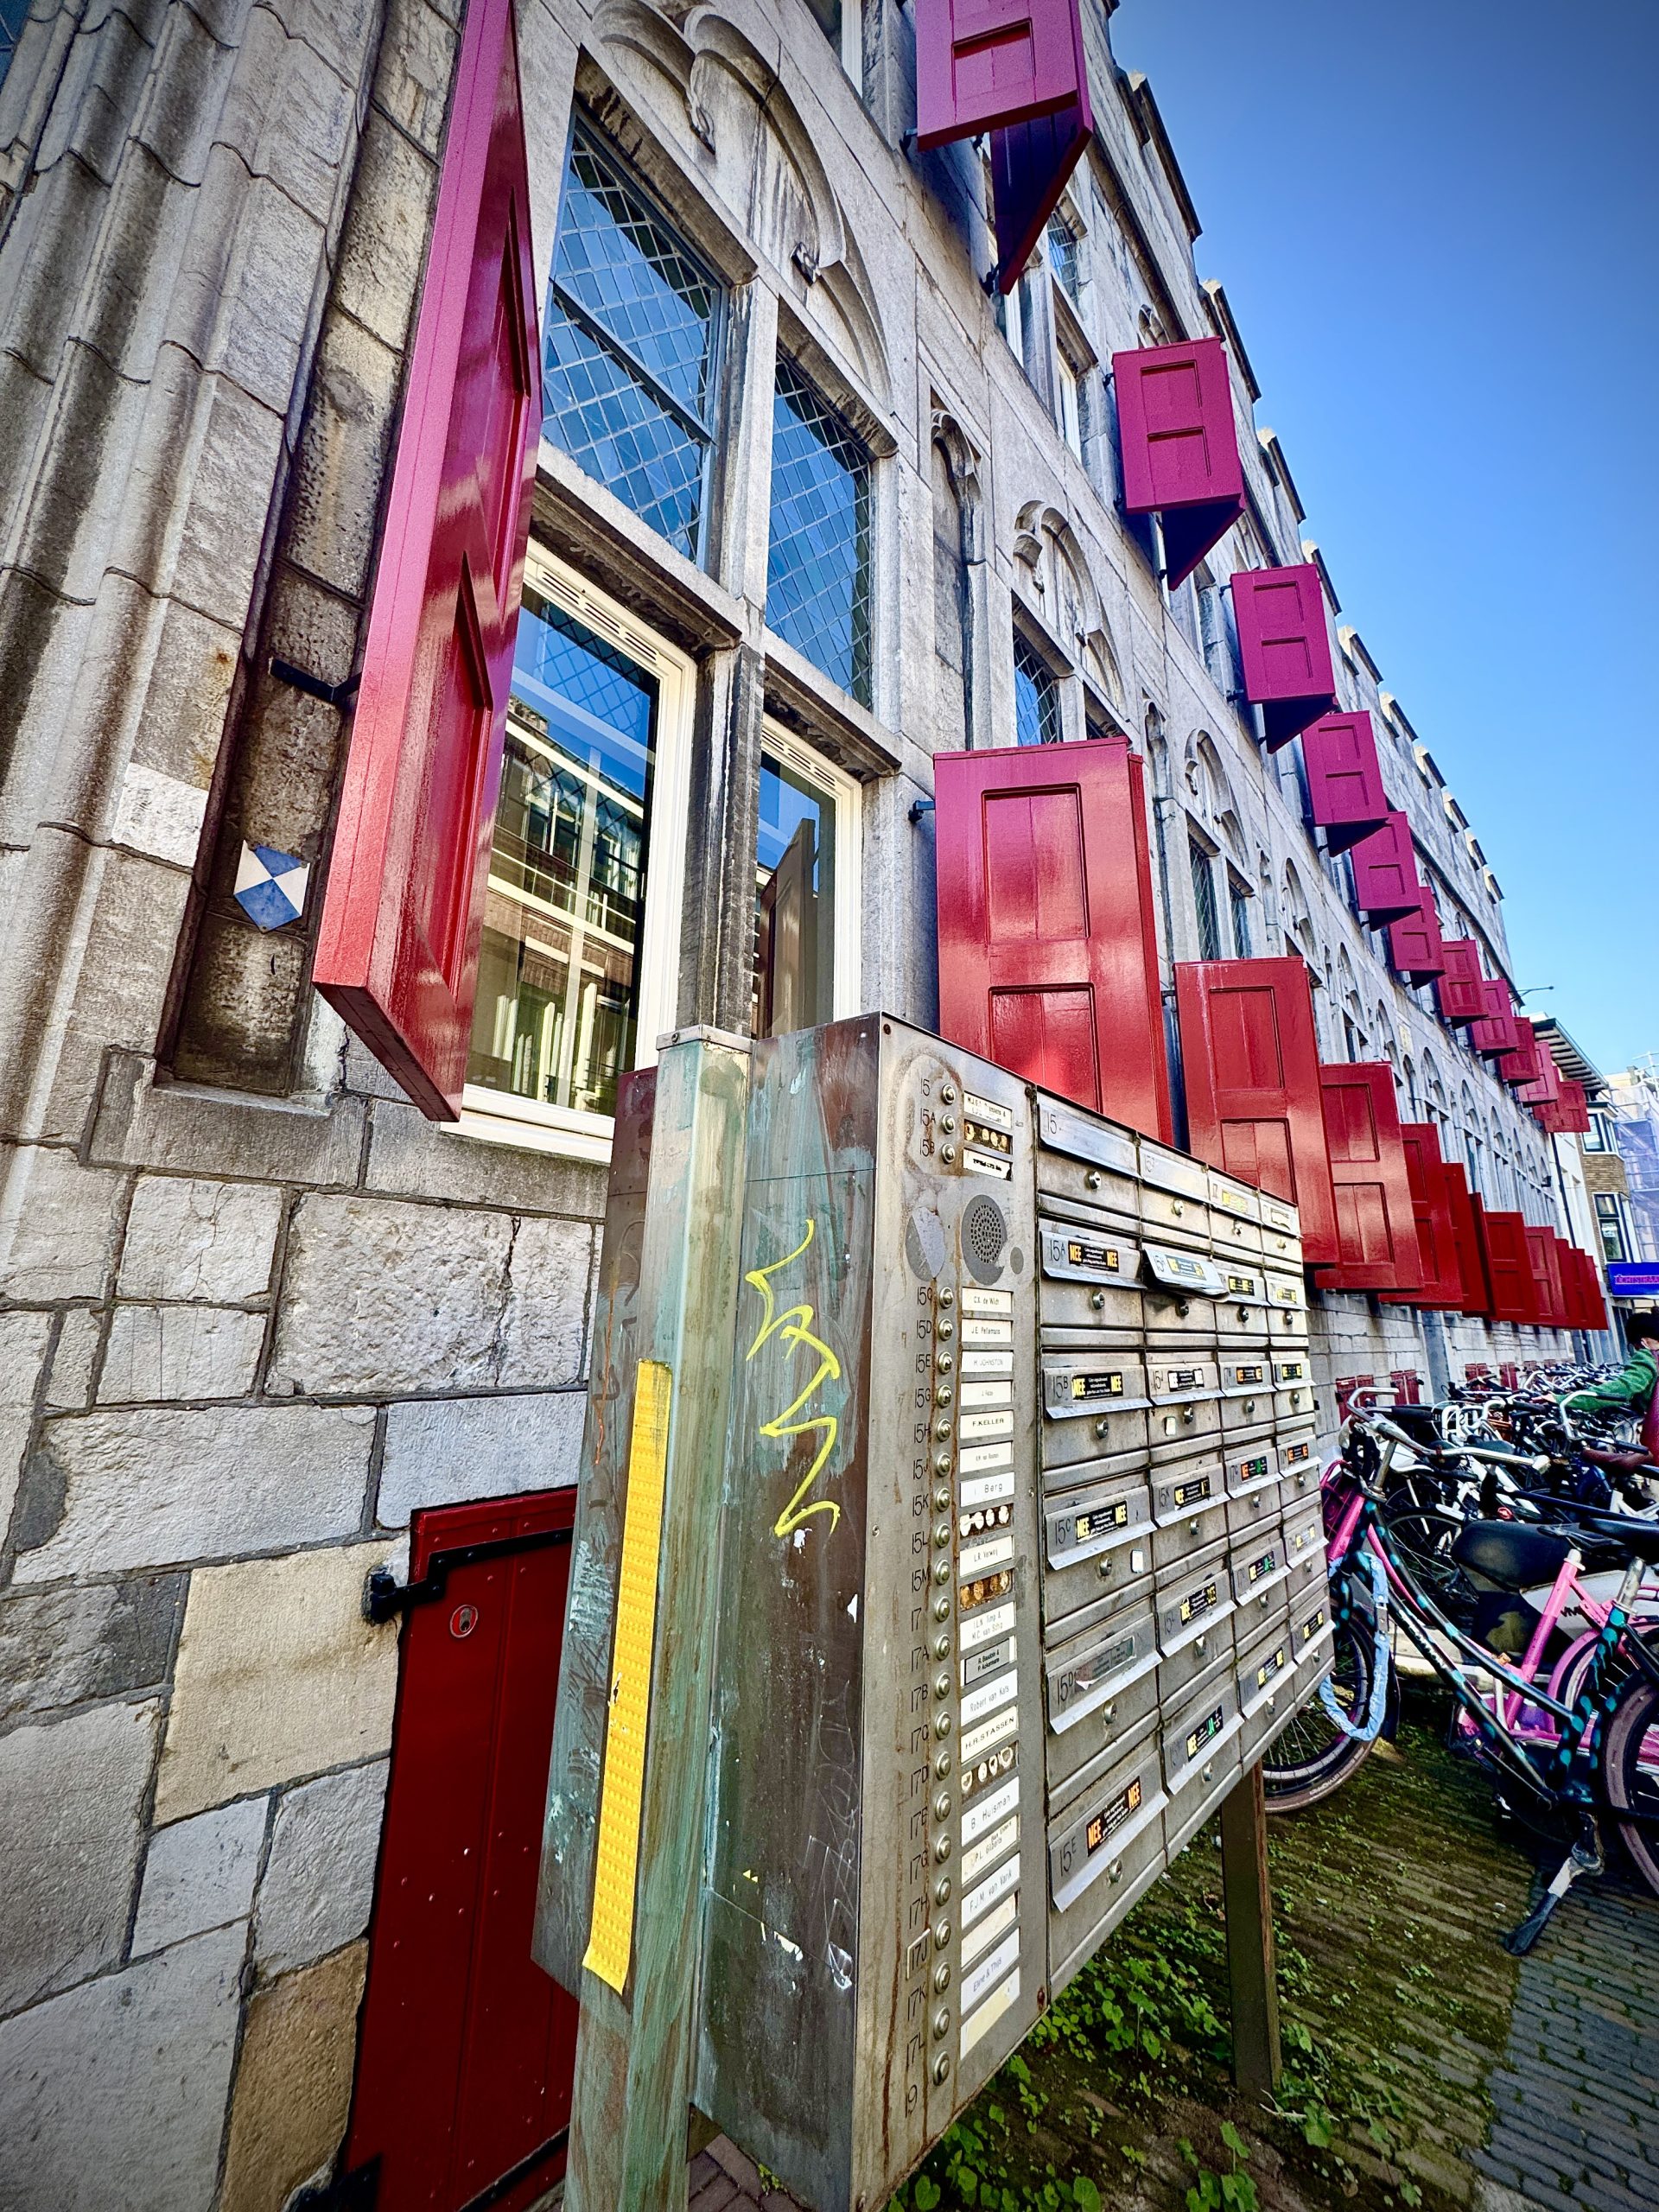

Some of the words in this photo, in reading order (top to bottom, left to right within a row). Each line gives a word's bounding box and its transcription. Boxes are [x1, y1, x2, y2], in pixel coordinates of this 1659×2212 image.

[920, 1077, 931, 1096] 15
[920, 1108, 936, 1127] 15A
[1047, 1112, 1057, 1135] 15
[919, 1139, 935, 1157] 15B
[1049, 1239, 1066, 1262] 15A
[1069, 1244, 1082, 1262] NEE
[1106, 1250, 1118, 1268] NEE
[916, 1320, 932, 1339] 15D
[916, 1354, 931, 1373] 15E
[1052, 1376, 1069, 1399] 15B
[1072, 1377, 1085, 1396] NEE
[1110, 1375, 1122, 1392] NEE
[915, 1388, 931, 1408] 15G
[913, 1422, 931, 1444] 15H
[912, 1458, 929, 1480] 15J
[912, 1493, 929, 1517] 15K
[1115, 1503, 1127, 1524] NEE
[1054, 1517, 1071, 1546] 15C
[1077, 1516, 1090, 1539] NEE
[912, 1531, 928, 1554] 15L
[911, 1607, 922, 1631] 17
[911, 1645, 930, 1673] 17A
[911, 1683, 929, 1713] 17B
[1057, 1671, 1074, 1706] 15D
[911, 1765, 929, 1797] 17D
[1128, 1781, 1141, 1809] NEE
[910, 1806, 928, 1840] 17E
[1088, 1818, 1102, 1849] NEE
[1059, 1835, 1077, 1877] 15E
[909, 1892, 928, 1929] 17H
[912, 1936, 927, 1971] 17J
[907, 1981, 926, 2022] 17K
[906, 2031, 925, 2066] 17L
[905, 2084, 918, 2119] 19
